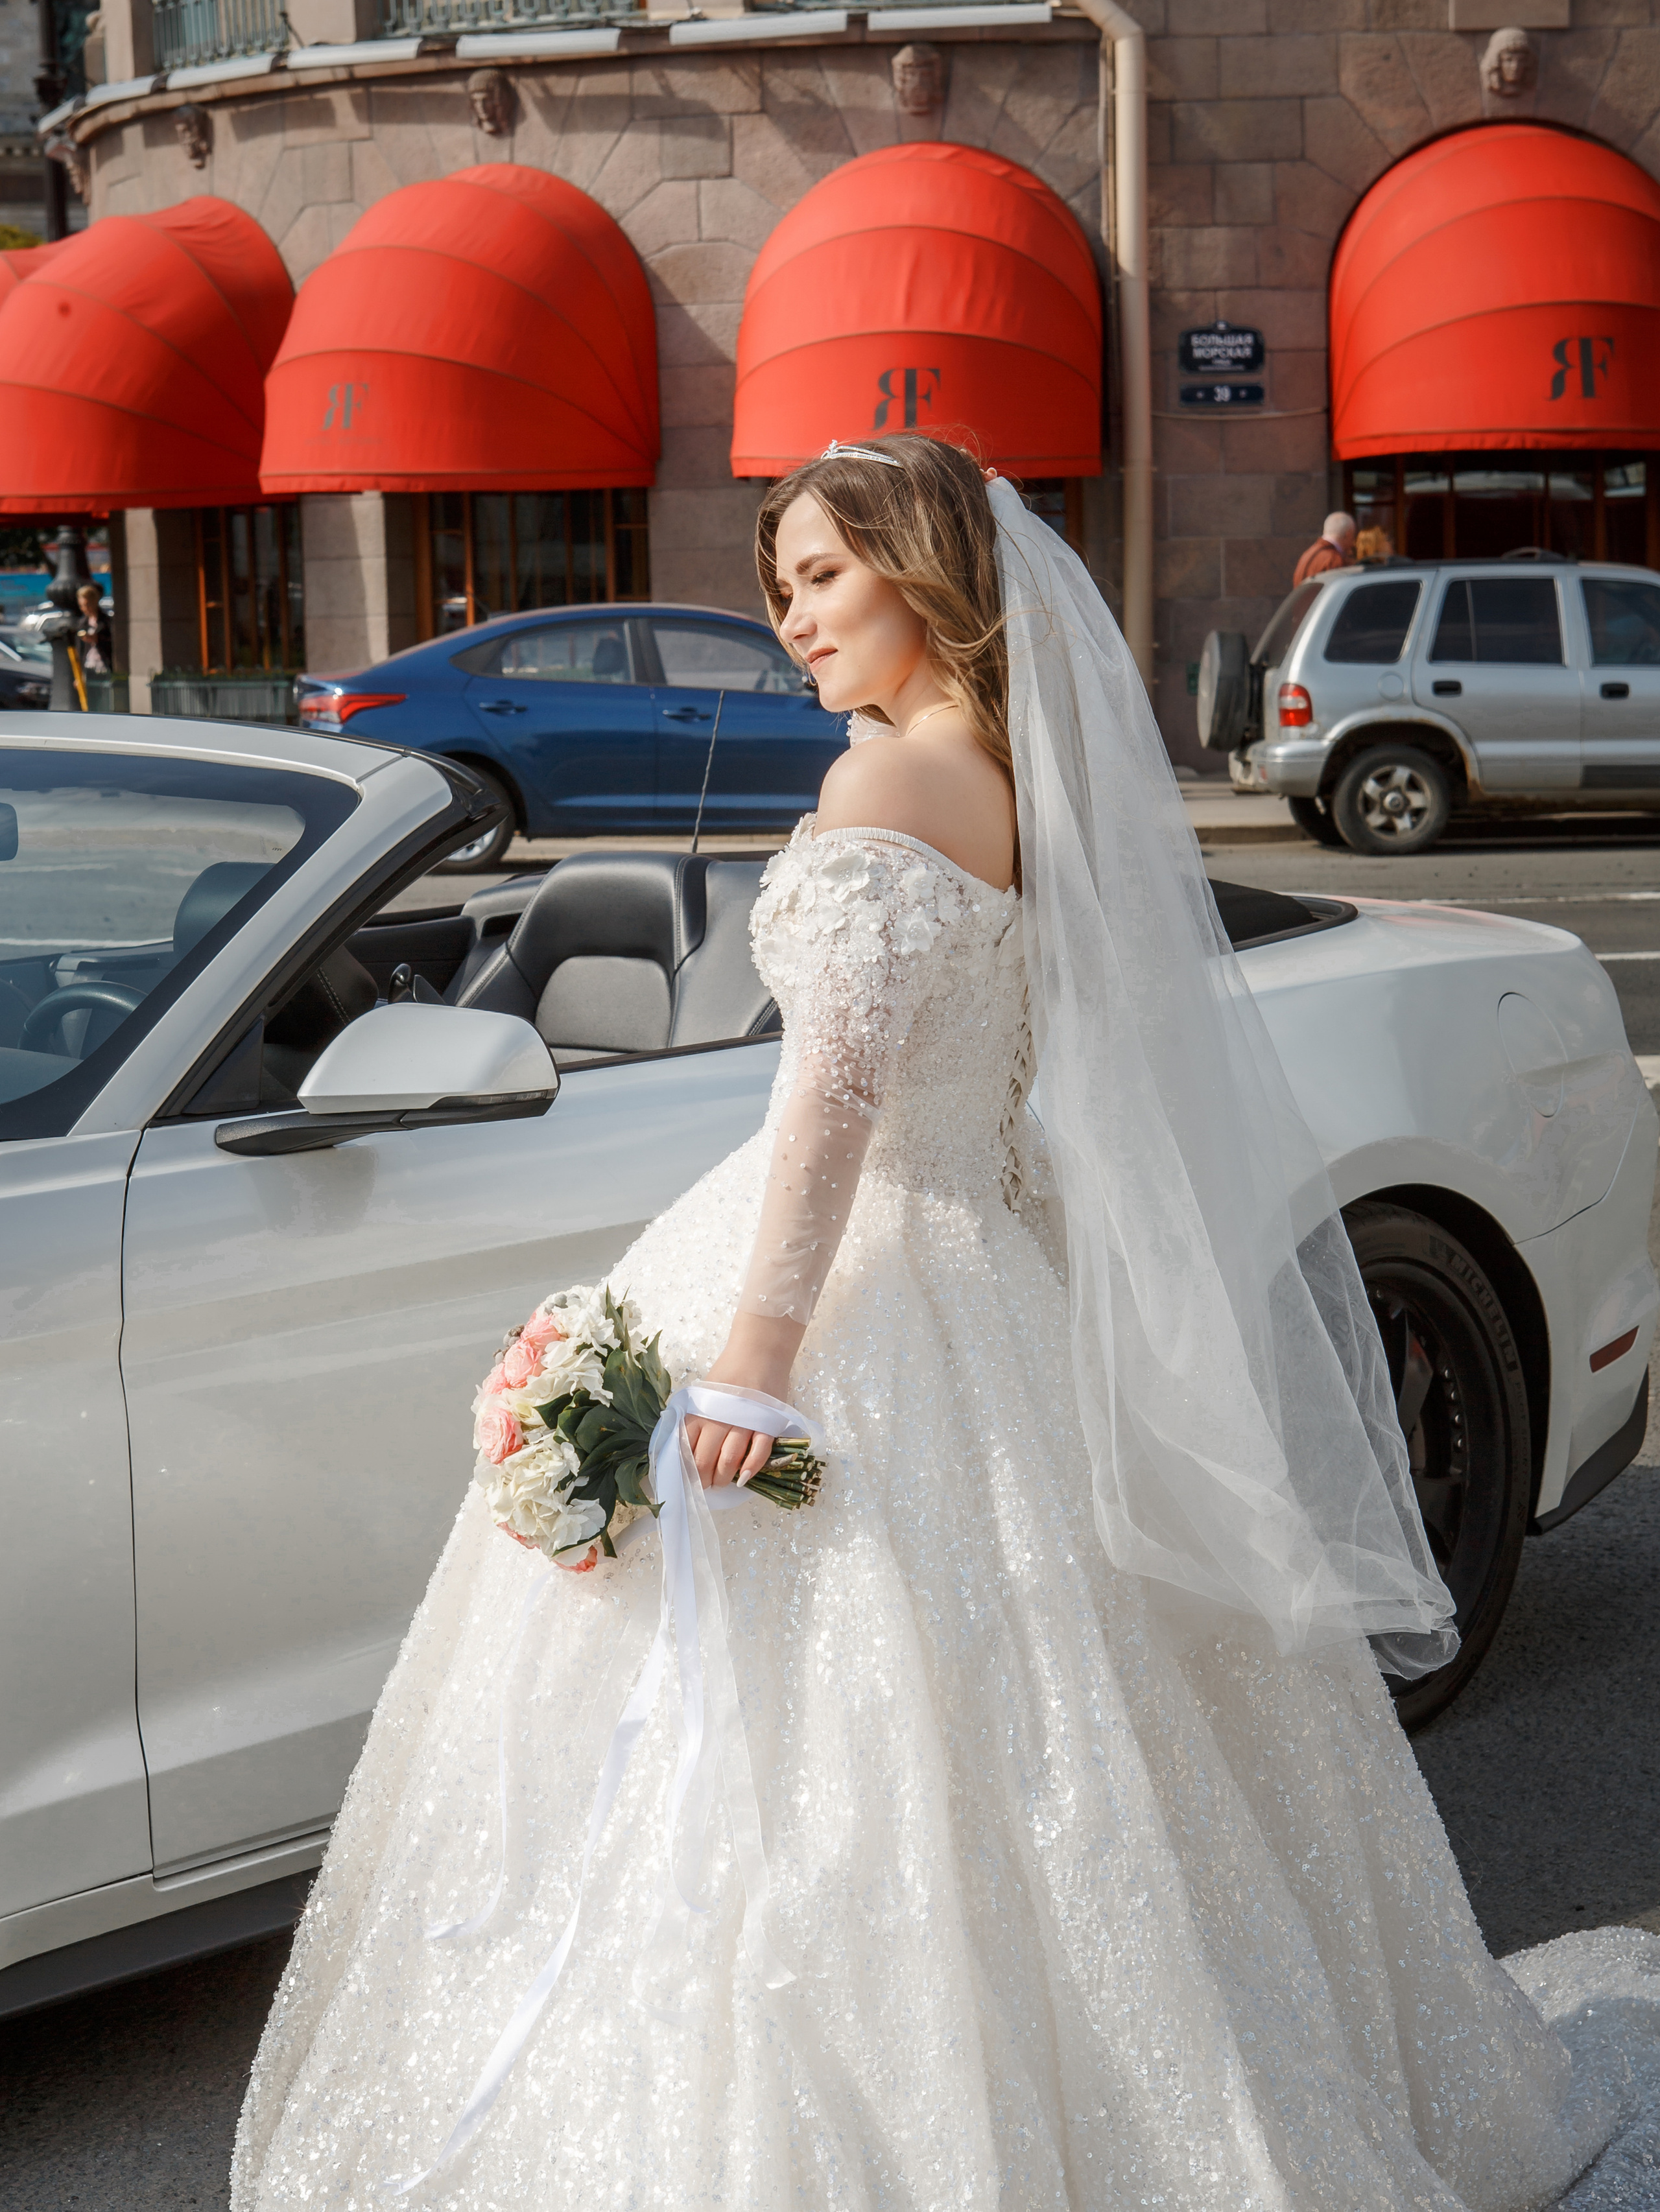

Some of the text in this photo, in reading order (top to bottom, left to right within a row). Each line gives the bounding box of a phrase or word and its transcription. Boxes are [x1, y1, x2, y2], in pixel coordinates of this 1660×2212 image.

[1191, 333, 1254, 346] БОЛЬШАЯ
[1192, 347, 1252, 359] МОРСКАЯ
[1450, 1253, 1517, 1363] MICHELIN
